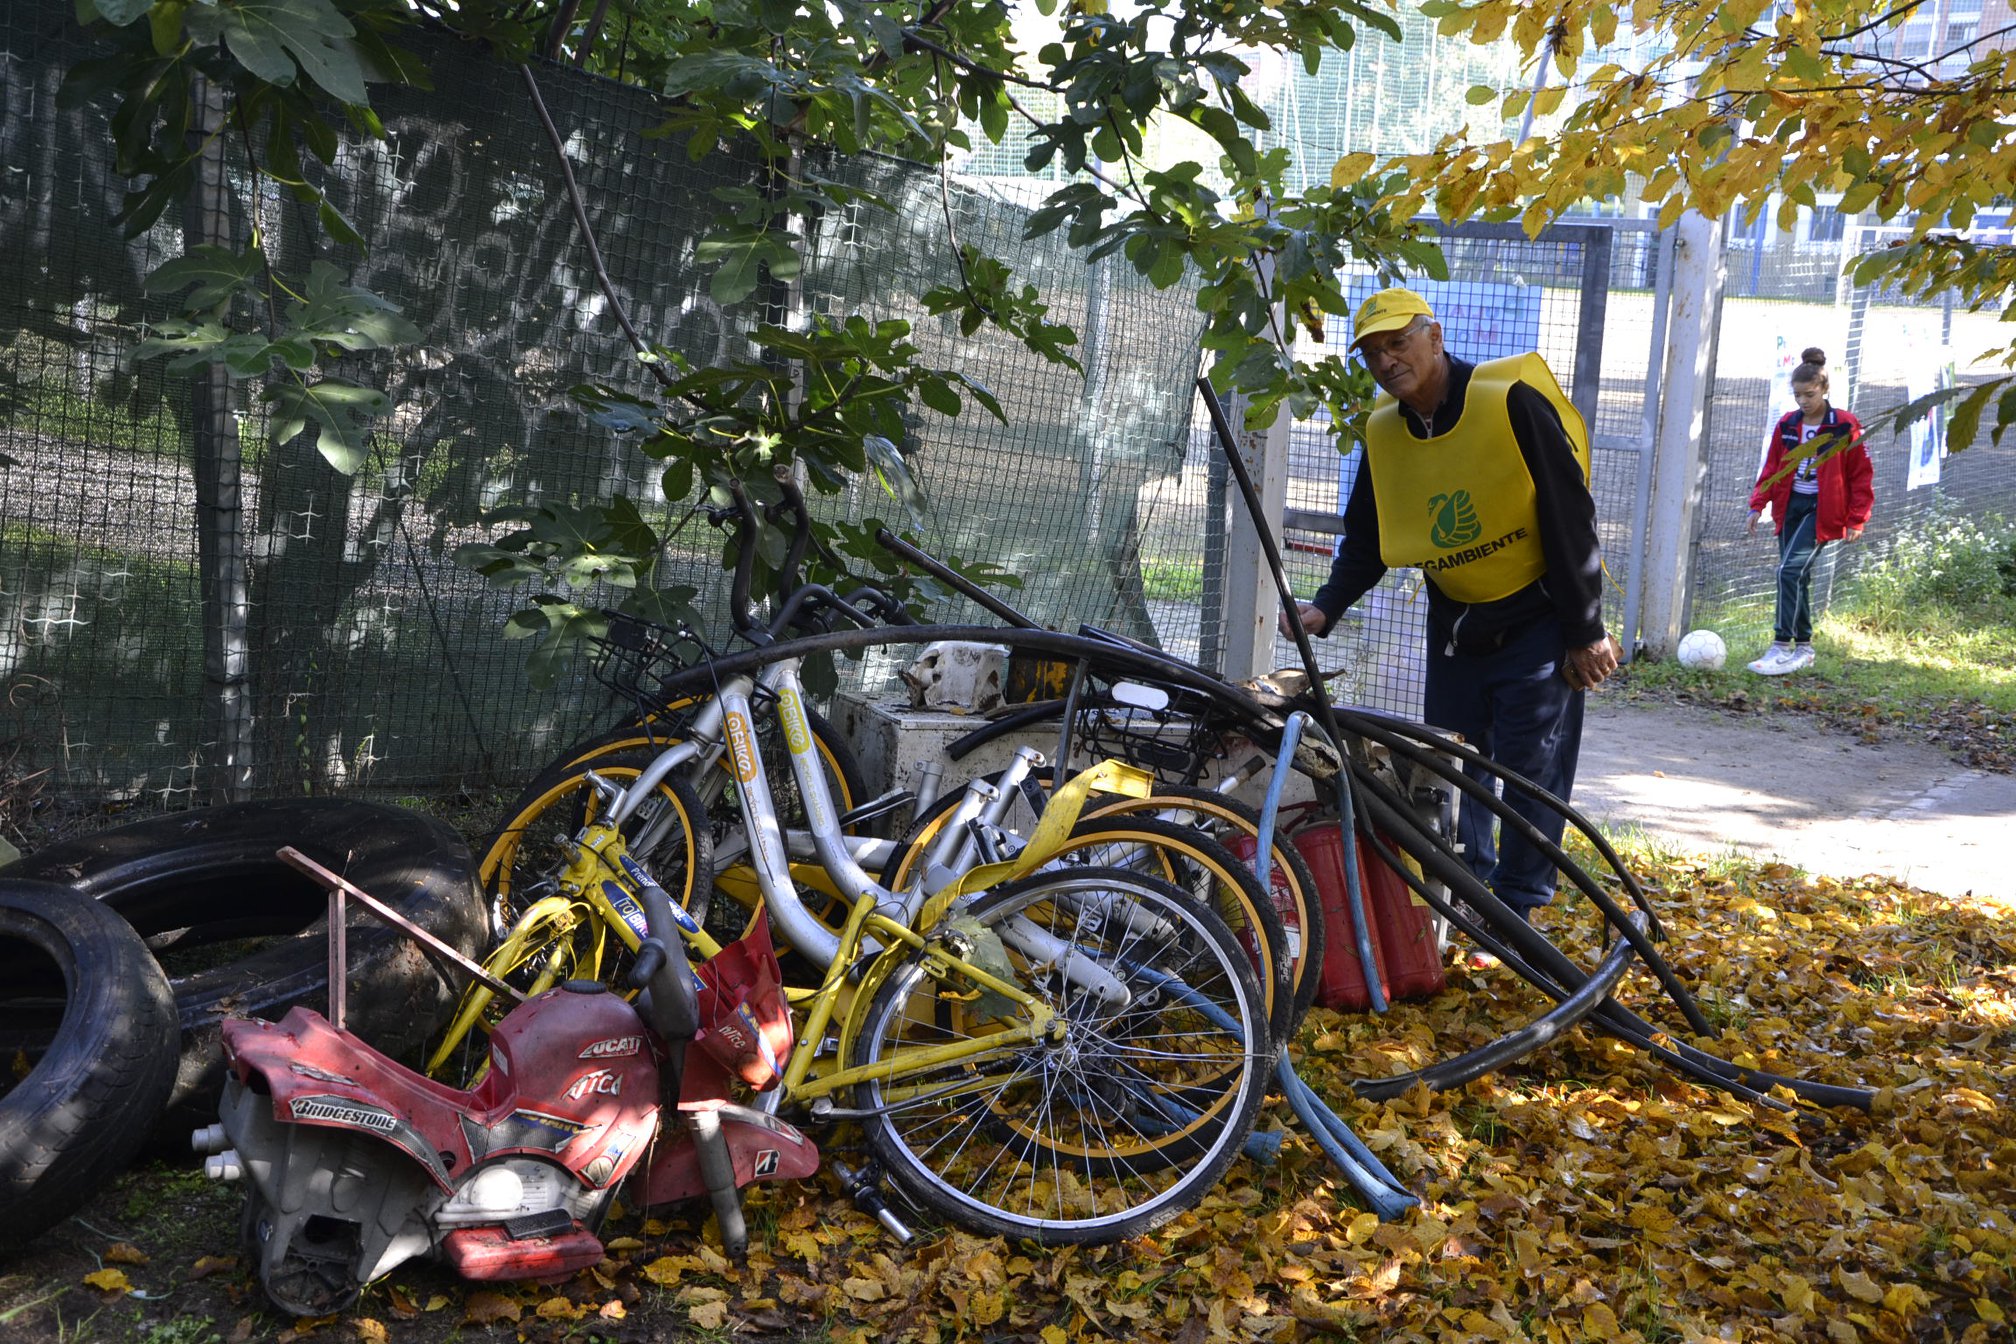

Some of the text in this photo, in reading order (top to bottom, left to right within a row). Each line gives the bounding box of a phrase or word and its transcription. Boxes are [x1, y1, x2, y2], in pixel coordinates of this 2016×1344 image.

[1406, 527, 1529, 571] GAMBIENTE
[630, 866, 656, 887] Prend
[295, 1100, 395, 1130] BRIDGESTONE
